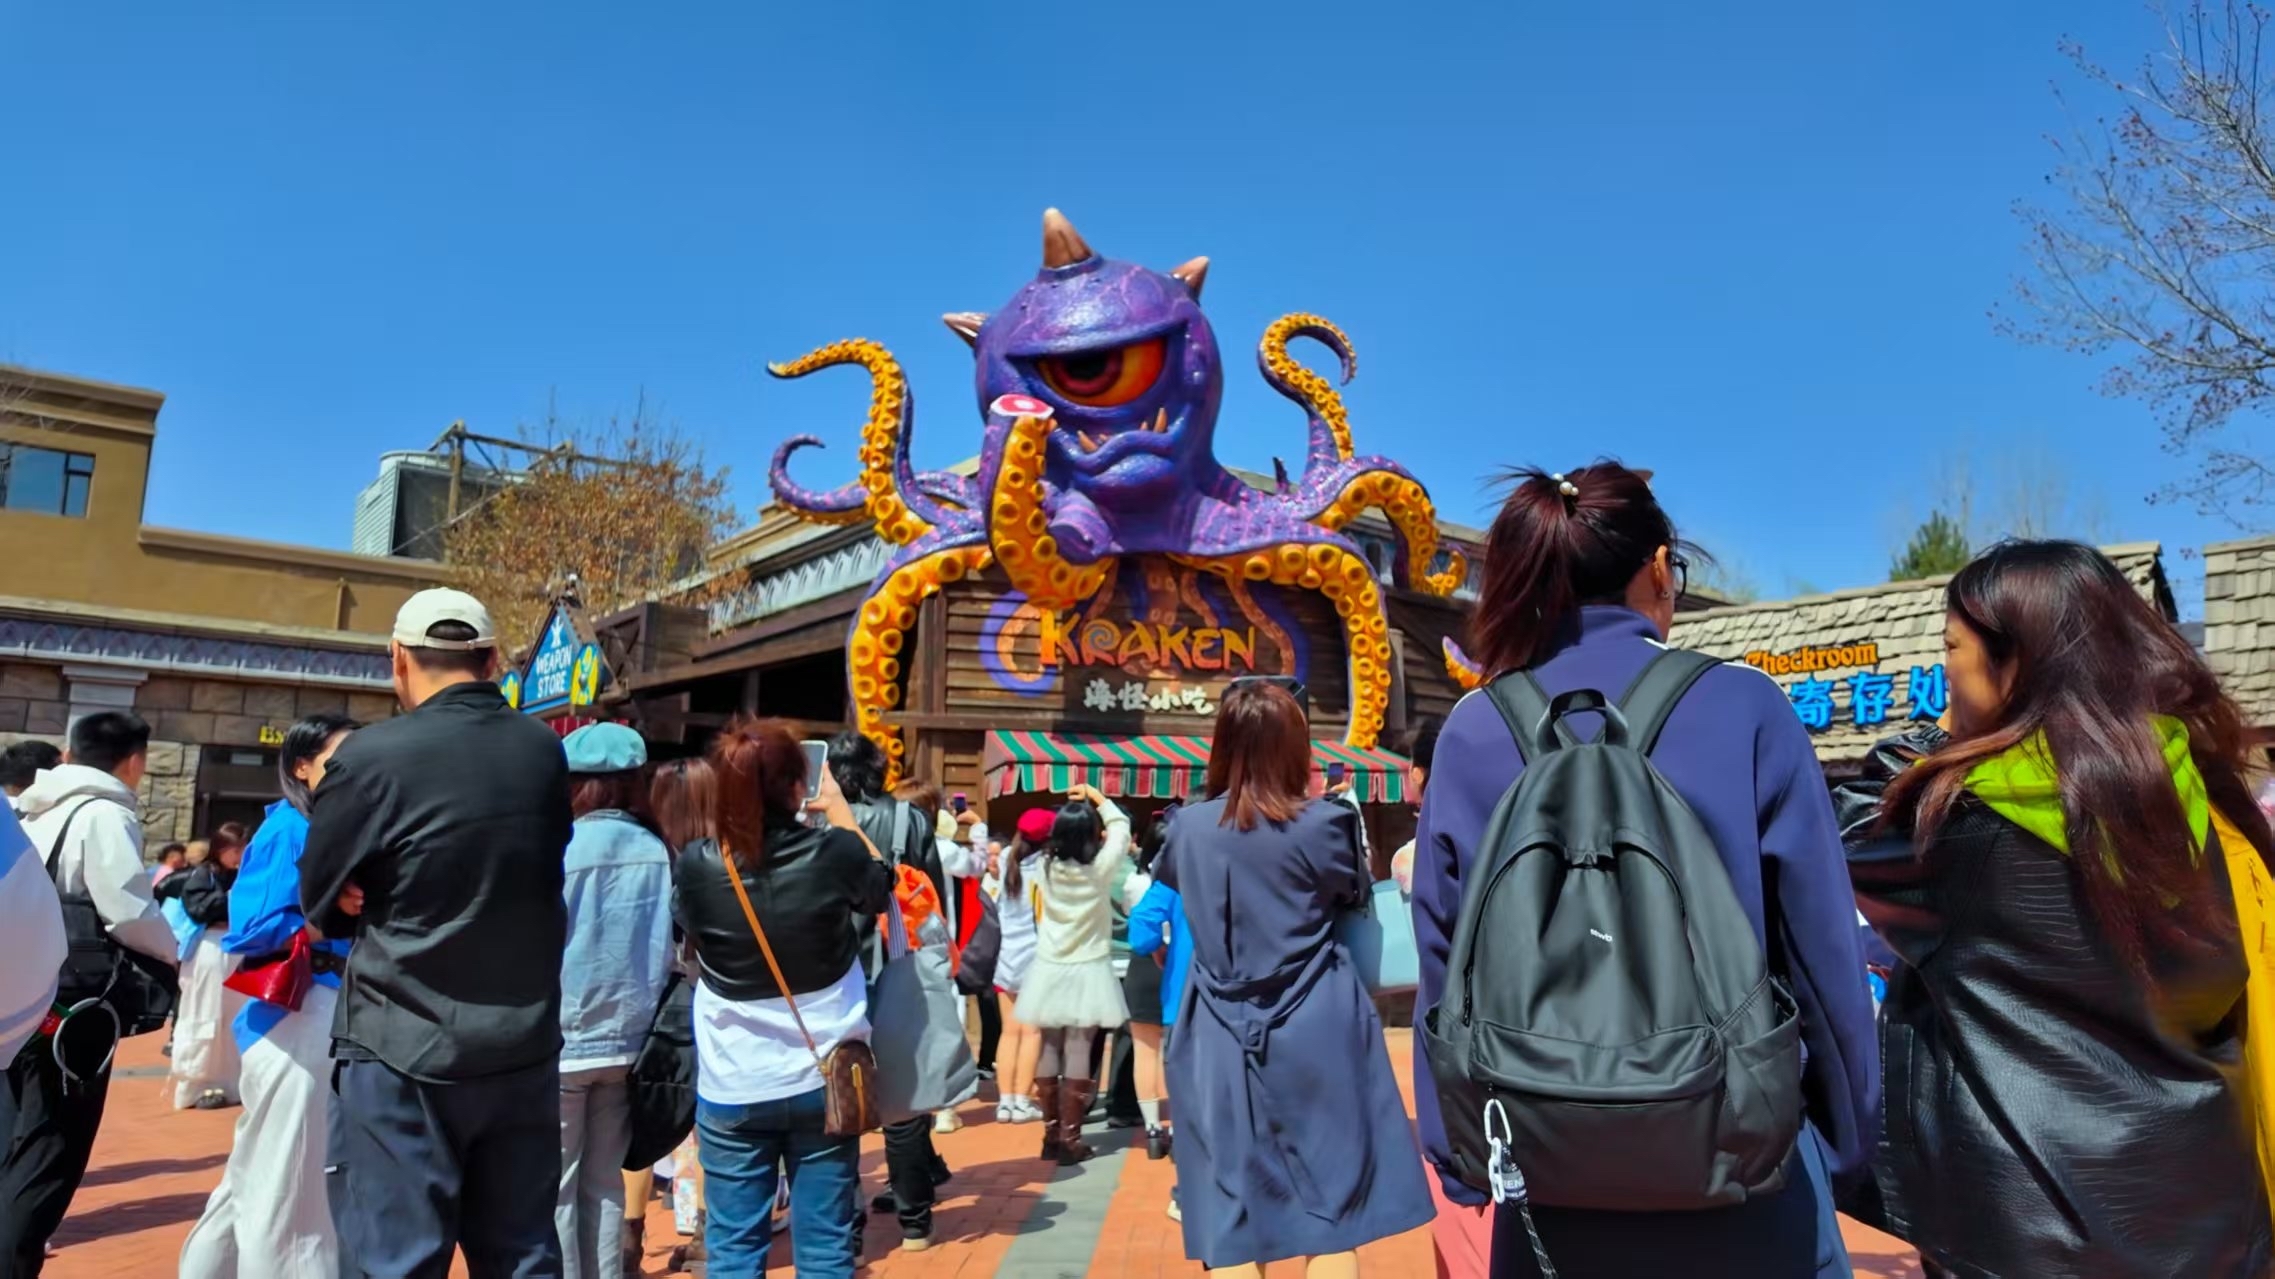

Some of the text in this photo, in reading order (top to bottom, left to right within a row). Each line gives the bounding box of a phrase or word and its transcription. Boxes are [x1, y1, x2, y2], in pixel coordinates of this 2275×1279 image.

[1039, 608, 1255, 670] KRAKEN
[536, 644, 573, 676] WEAPON
[1744, 643, 1878, 675] Checkroom
[537, 670, 567, 699] STORE
[1790, 663, 1949, 729] 寄存处
